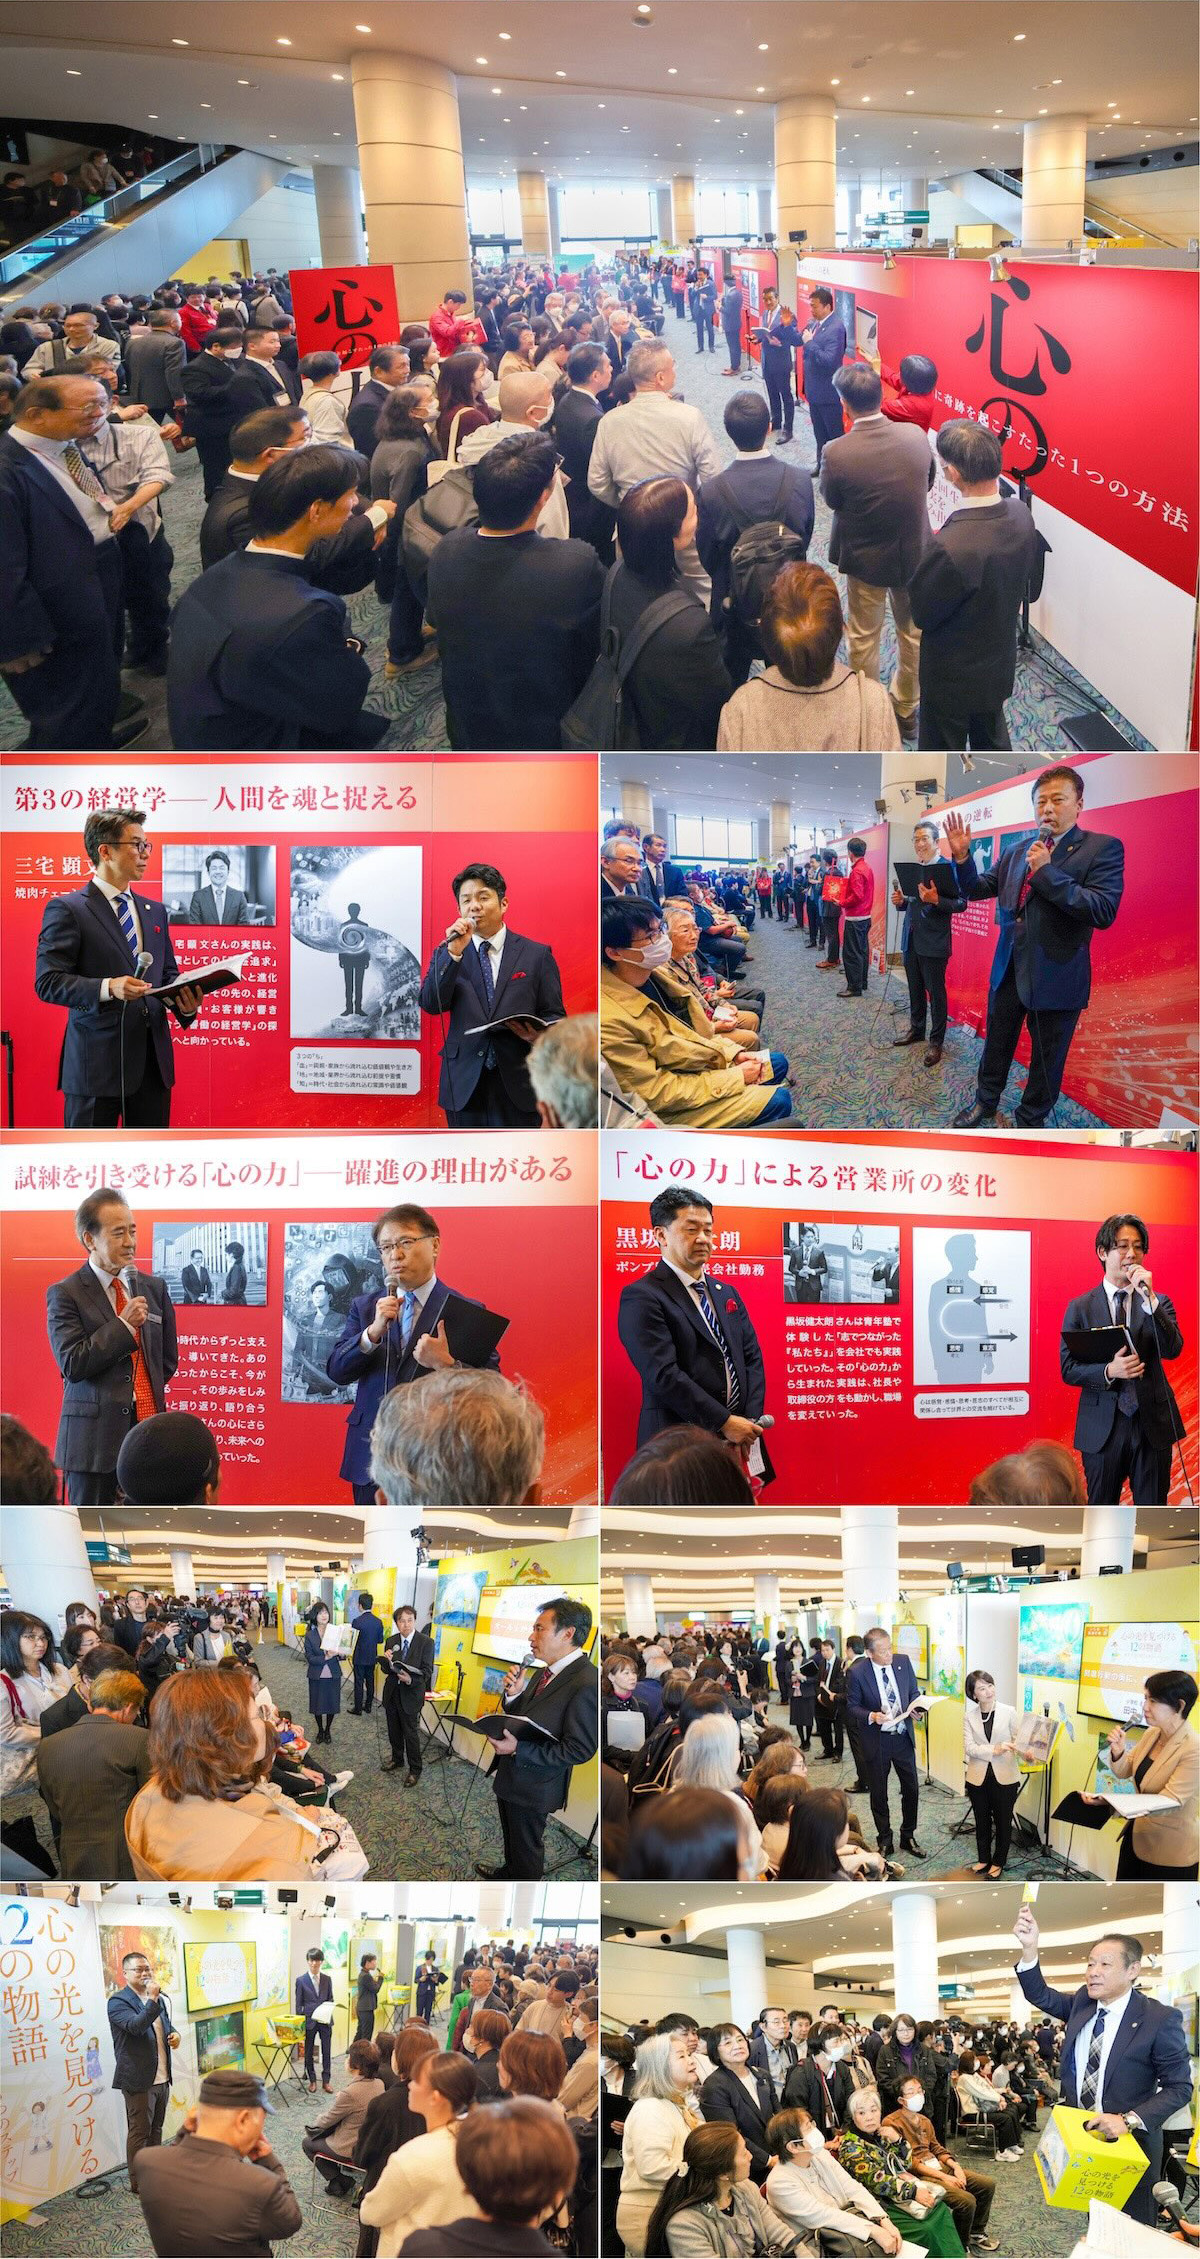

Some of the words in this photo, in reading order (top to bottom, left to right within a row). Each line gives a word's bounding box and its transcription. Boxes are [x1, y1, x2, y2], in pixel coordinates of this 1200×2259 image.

[965, 275, 1071, 477] 心の
[15, 857, 55, 876] 三宅
[204, 988, 277, 999] その先の、経営
[616, 1151, 997, 1197] 「心の力」による営業所の変化
[177, 1335, 267, 1347] 時代からずっと支え
[0, 1903, 48, 2067] 2の物語
[38, 1905, 98, 2175] 心の光を見つける
